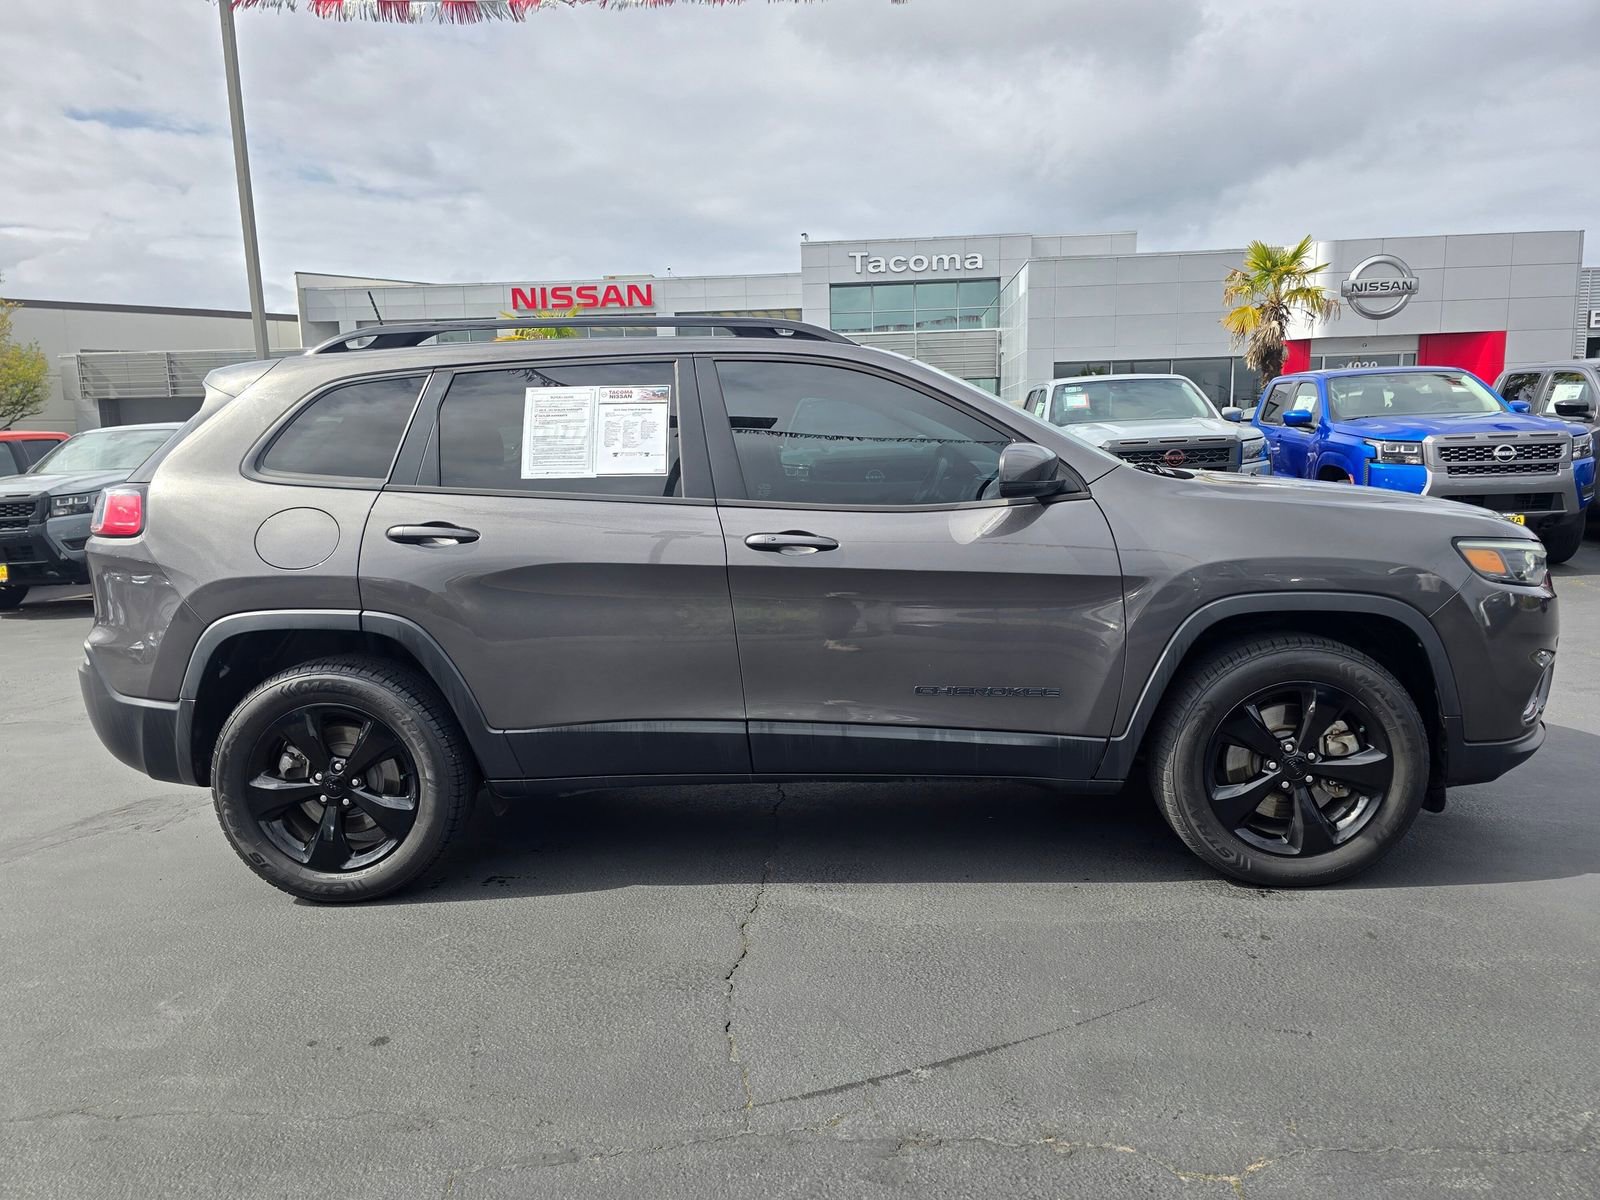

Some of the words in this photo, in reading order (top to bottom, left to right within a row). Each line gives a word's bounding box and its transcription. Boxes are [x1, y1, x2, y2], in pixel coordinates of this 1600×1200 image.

[848, 251, 984, 274] Tacoma
[1351, 280, 1412, 293] NISSAN
[511, 284, 653, 310] NISSAN
[914, 685, 1062, 697] CHEROKEE
